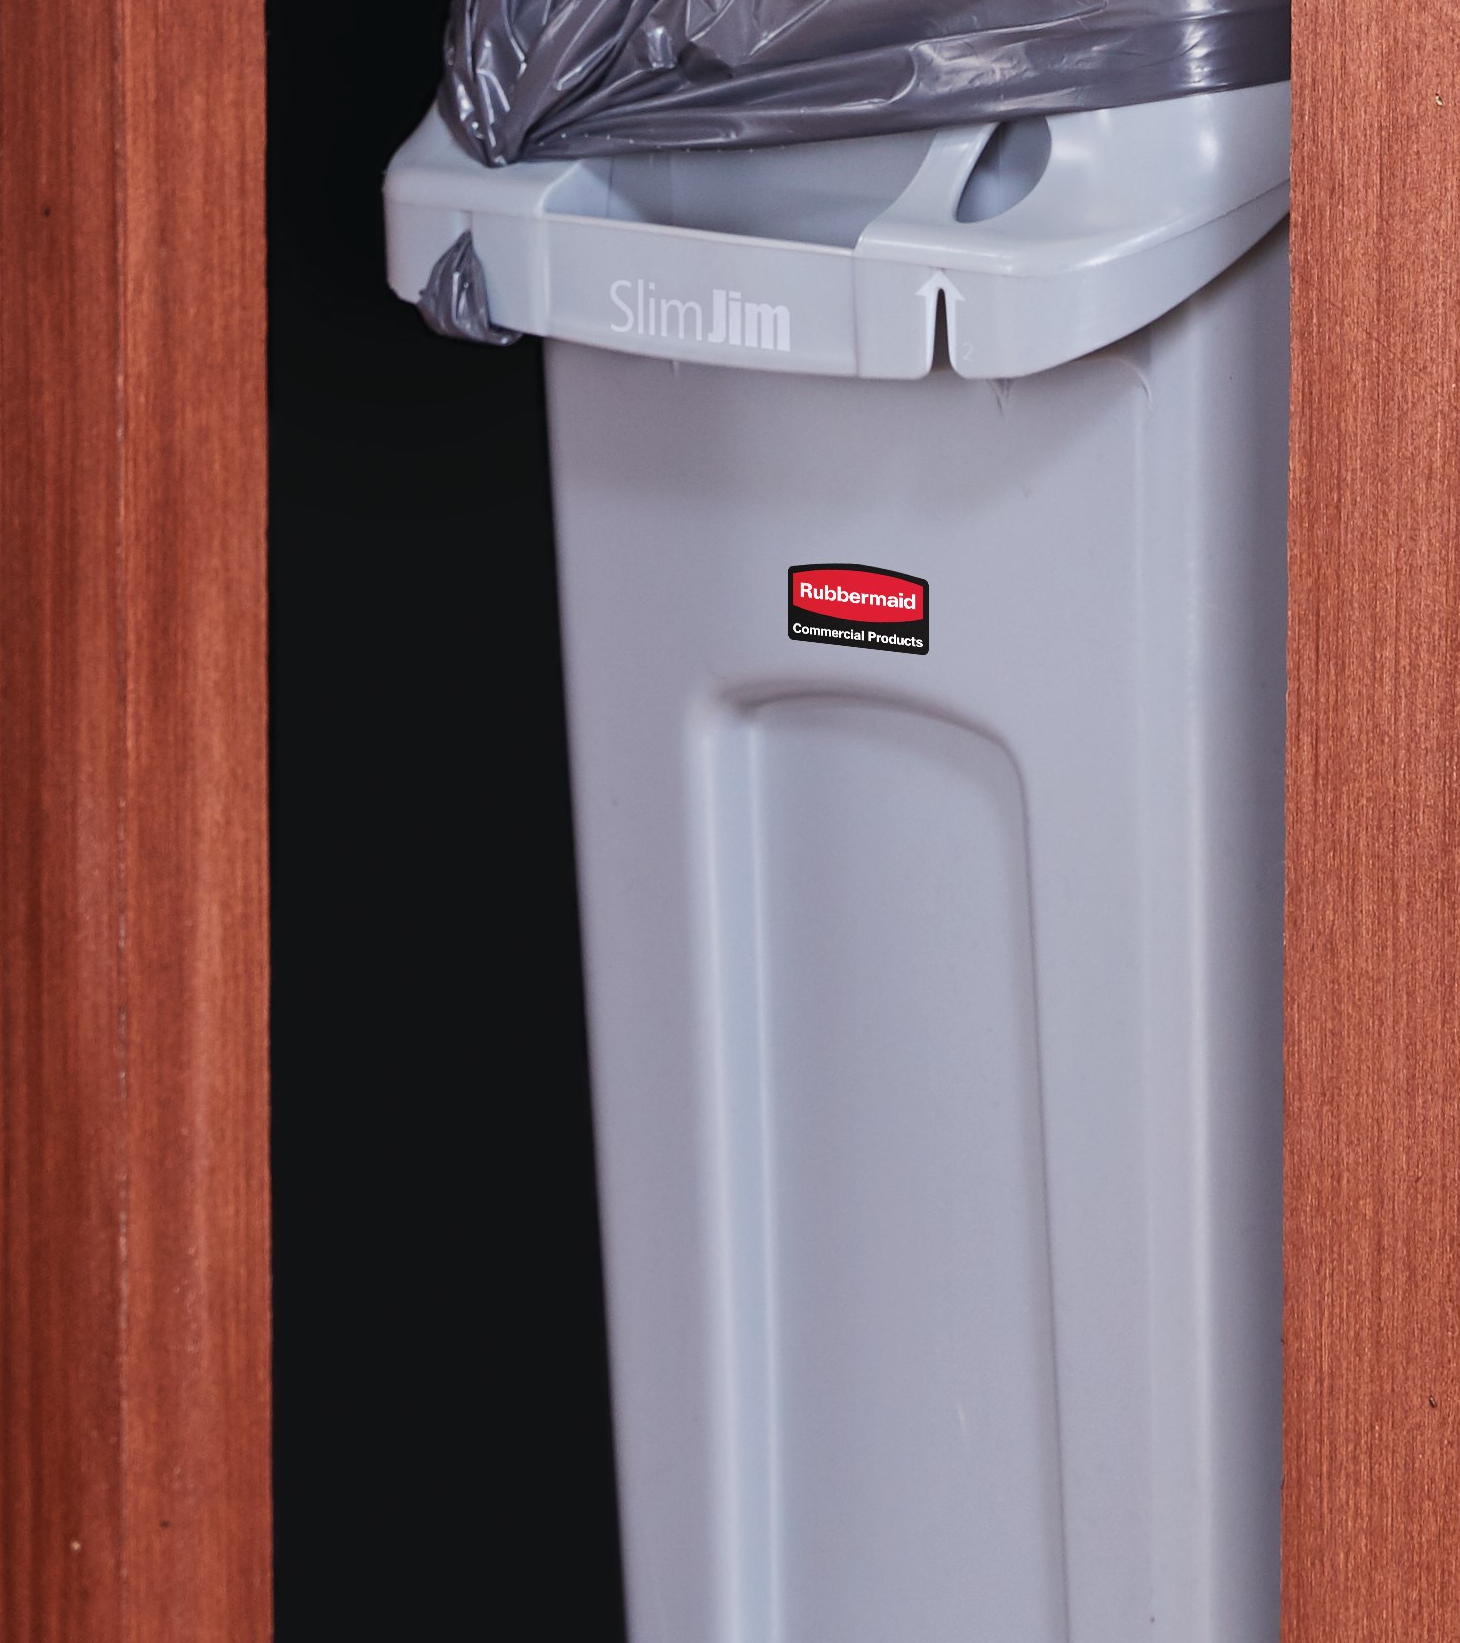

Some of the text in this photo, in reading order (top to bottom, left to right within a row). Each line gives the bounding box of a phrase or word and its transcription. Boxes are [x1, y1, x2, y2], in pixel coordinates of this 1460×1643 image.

[800, 582, 916, 610] Rubbermaid
[792, 622, 924, 648] Commercial Products
